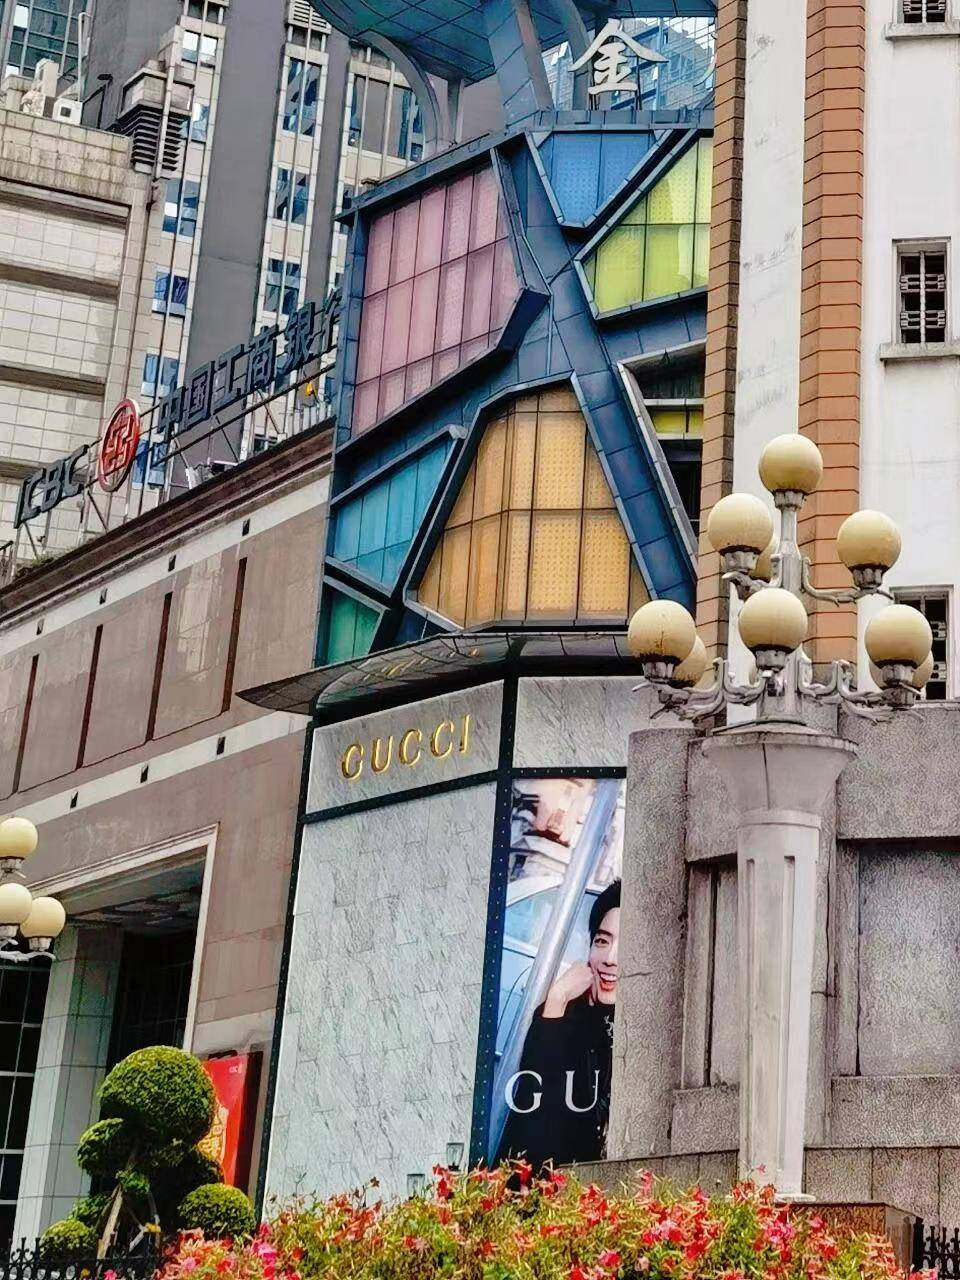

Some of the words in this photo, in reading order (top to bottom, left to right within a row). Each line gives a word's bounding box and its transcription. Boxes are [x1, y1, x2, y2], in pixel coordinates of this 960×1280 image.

[14, 444, 89, 529] ICBC
[341, 713, 471, 781] GUCCI
[504, 1069, 600, 1114] GU
